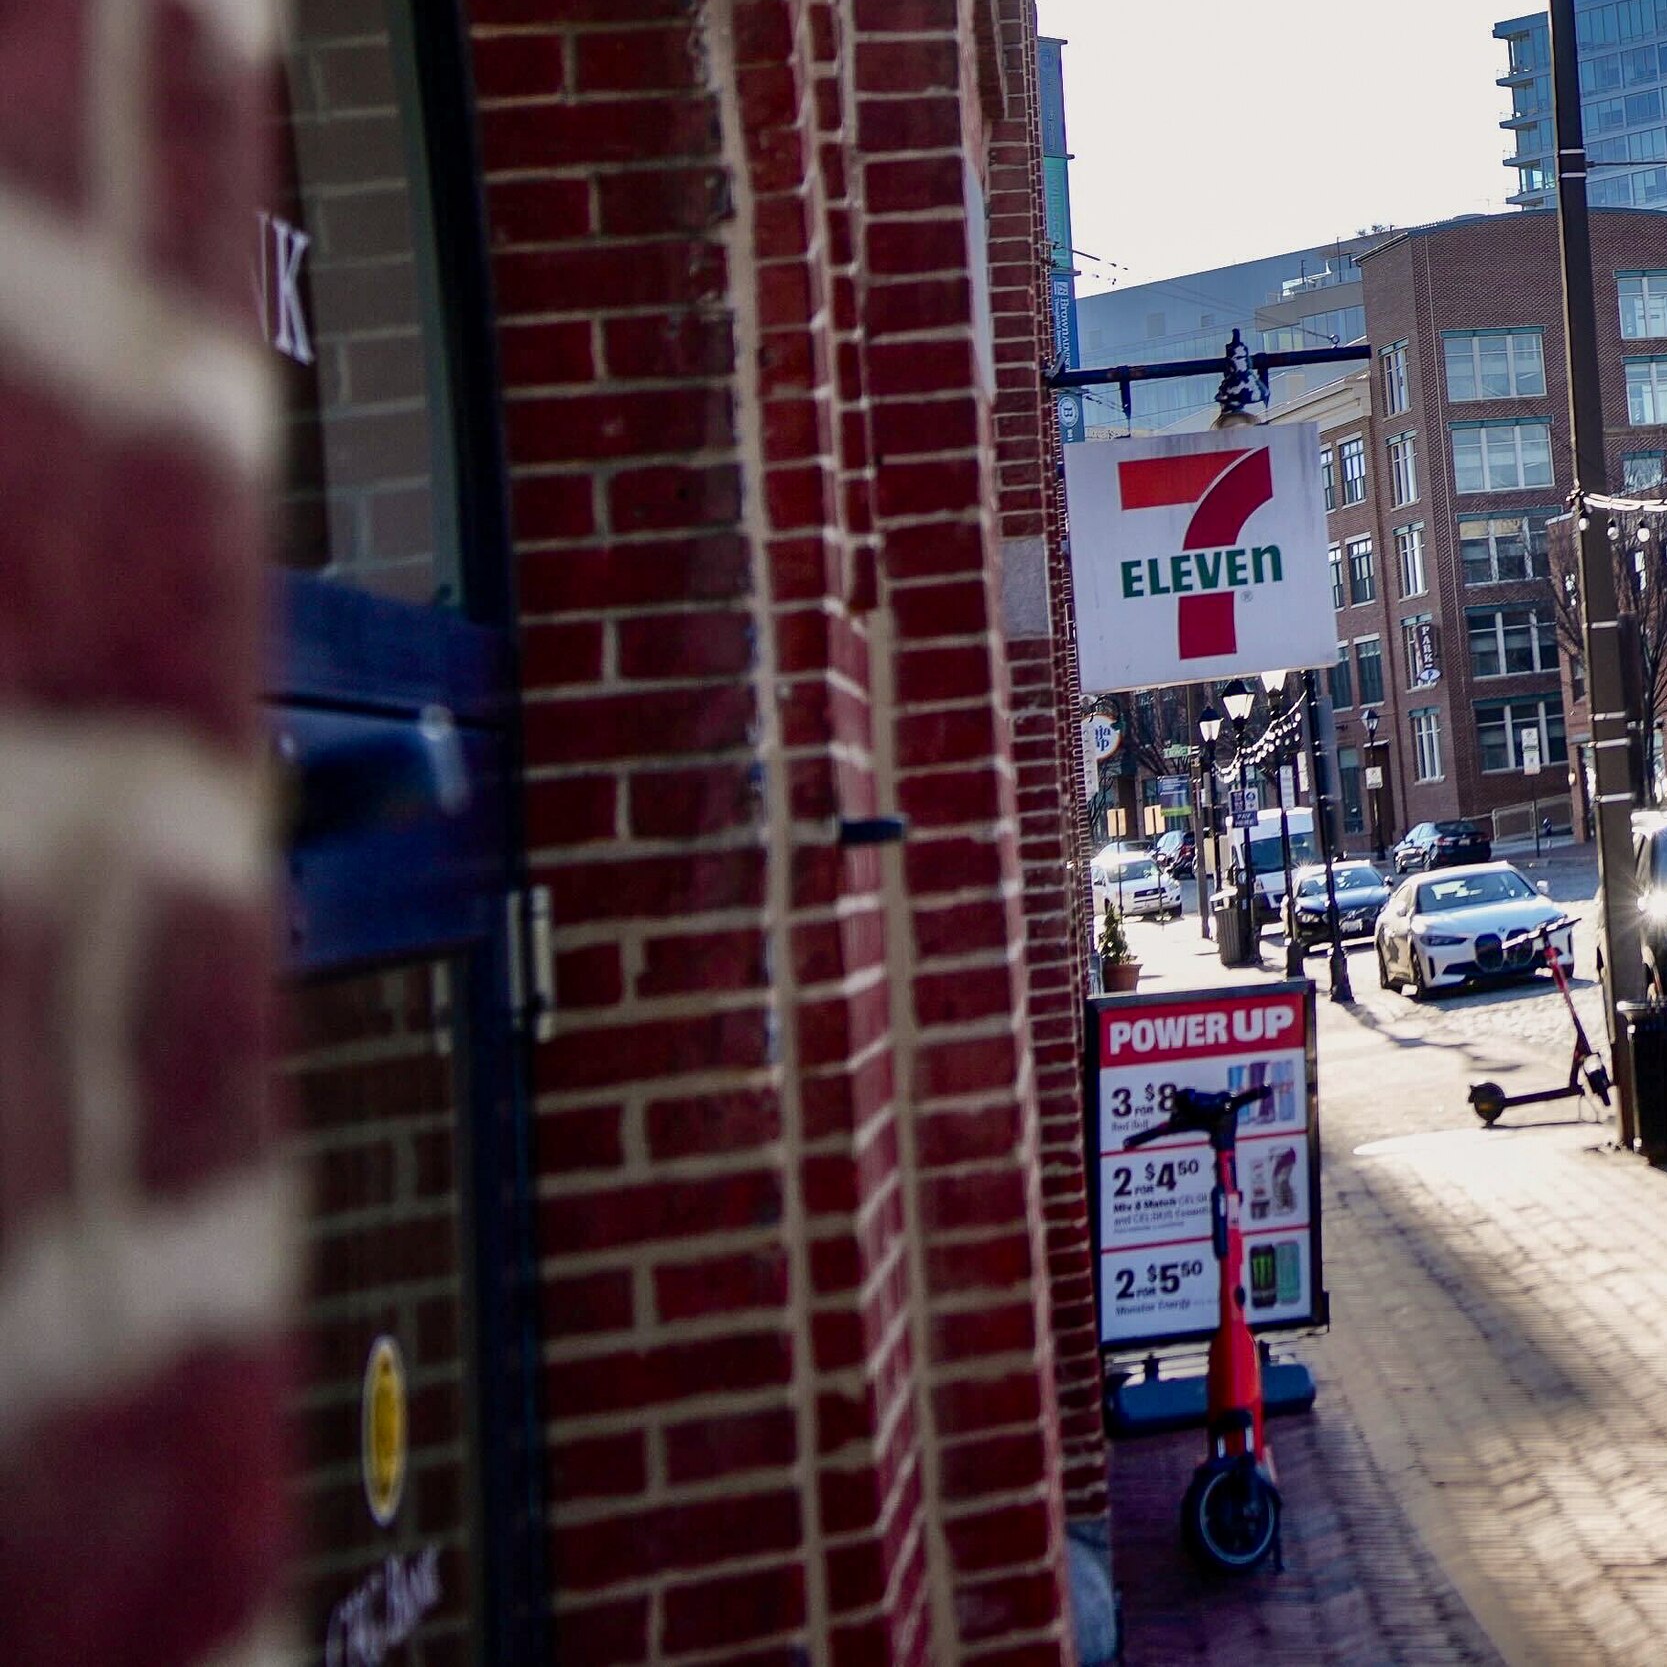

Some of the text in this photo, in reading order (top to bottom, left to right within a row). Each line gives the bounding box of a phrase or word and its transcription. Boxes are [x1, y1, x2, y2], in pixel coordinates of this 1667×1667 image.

[1117, 445, 1273, 661] 7
[1109, 1005, 1295, 1056] POWER UP
[1112, 1087, 1132, 1118] 3
[1113, 1166, 1132, 1198] 2
[1116, 1268, 1135, 1300] 2
